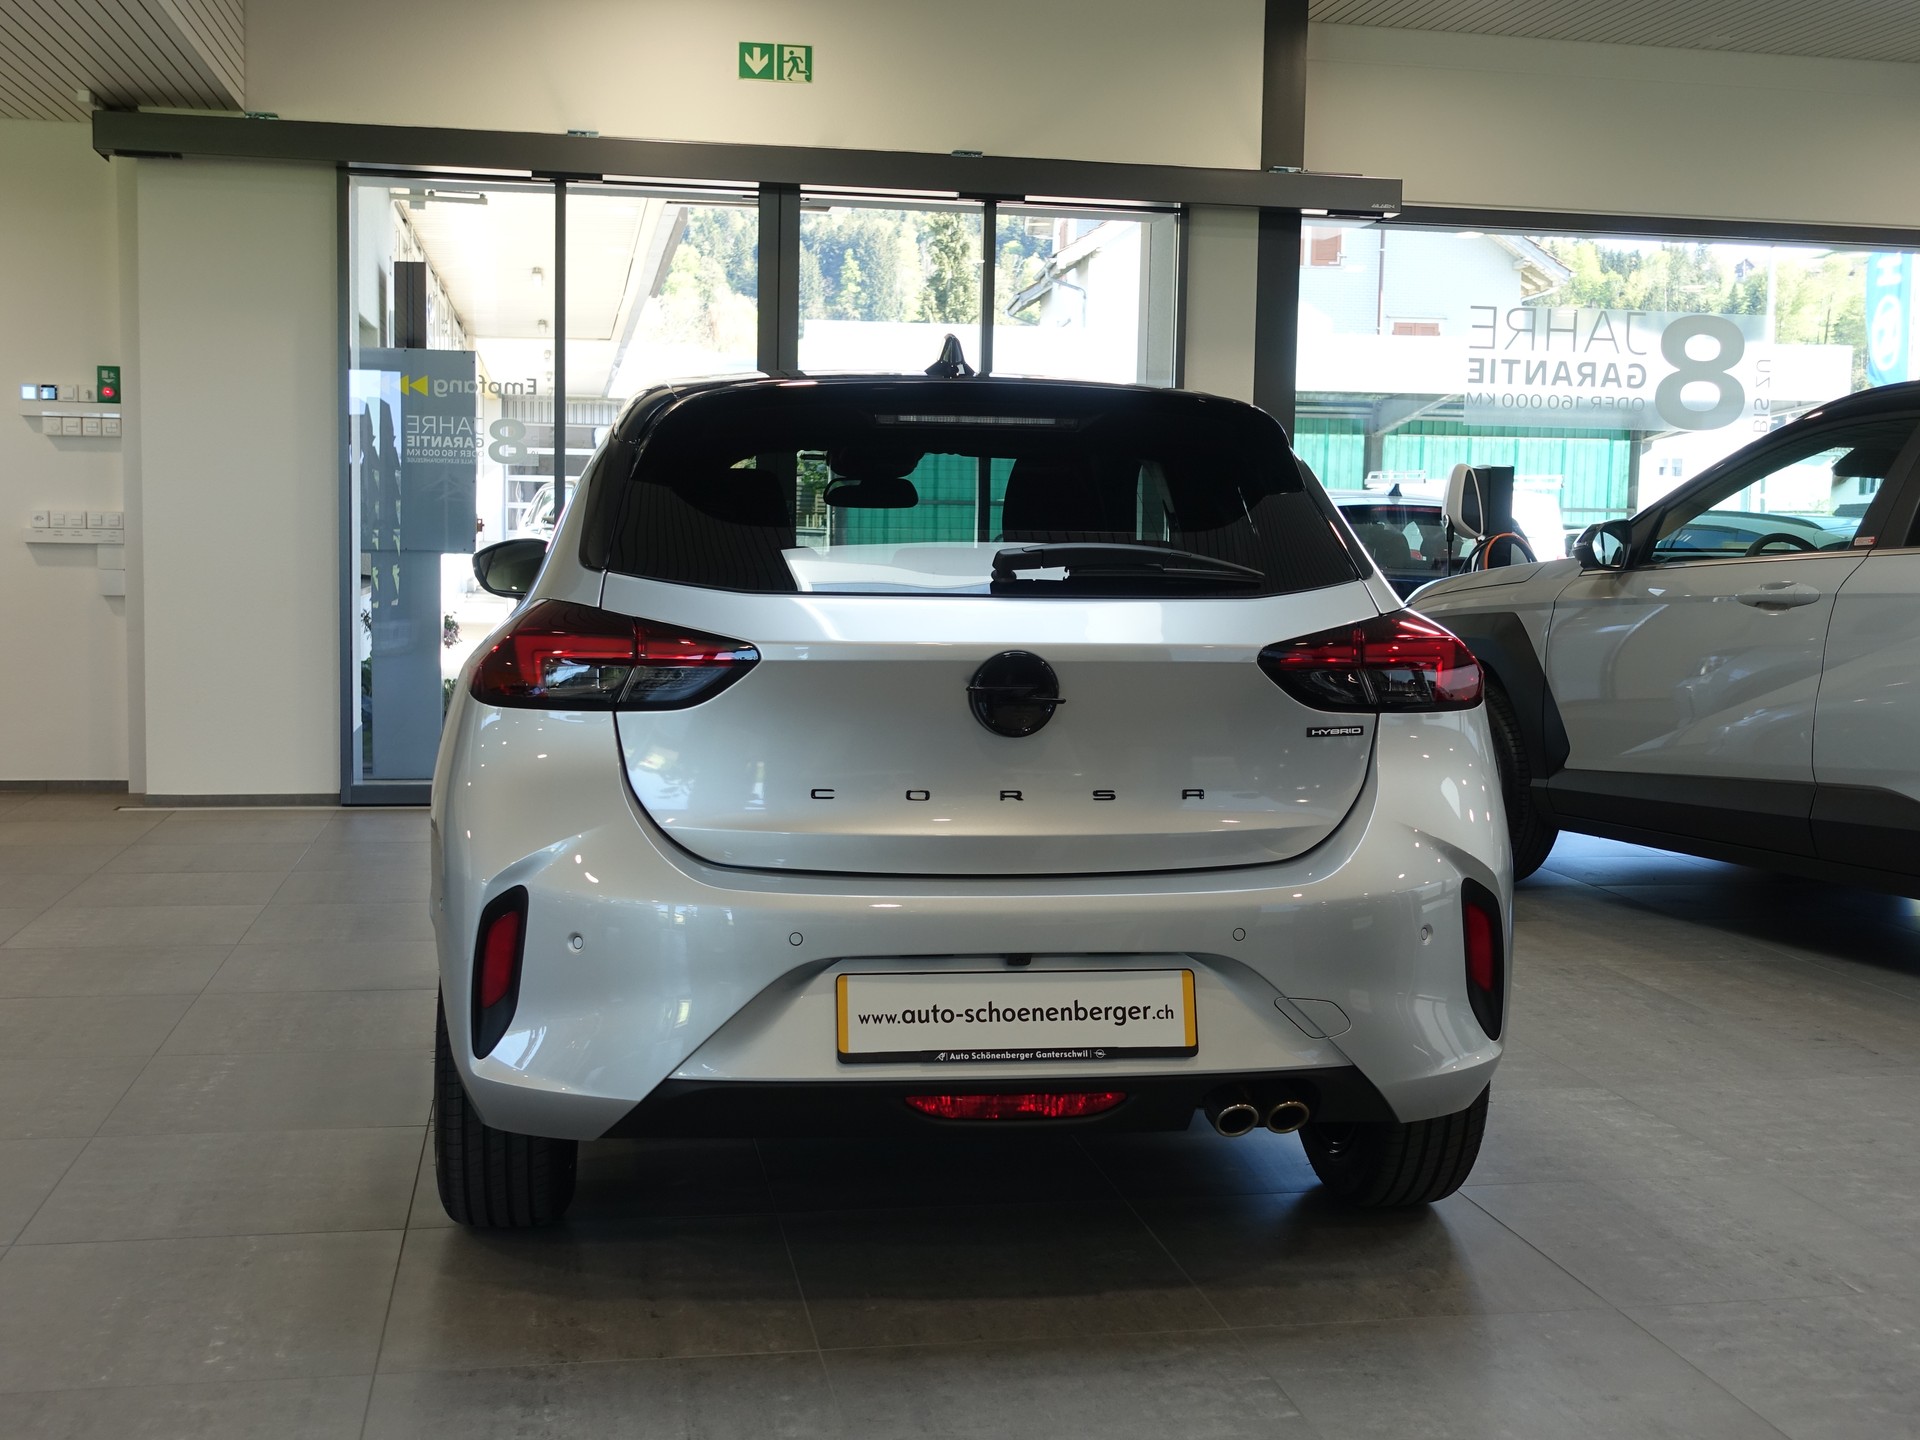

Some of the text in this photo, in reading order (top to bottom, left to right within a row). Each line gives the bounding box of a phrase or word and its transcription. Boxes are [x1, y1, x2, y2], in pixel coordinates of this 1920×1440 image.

[1311, 727, 1362, 736] HYBRID
[810, 788, 1205, 802] CORSA
[858, 1000, 1175, 1027] www.auto-schoenenberger.ch
[950, 1052, 970, 1060] Auto
[971, 1051, 1034, 1061] Schönenberger
[1036, 1049, 1089, 1059] Ganterschwil
